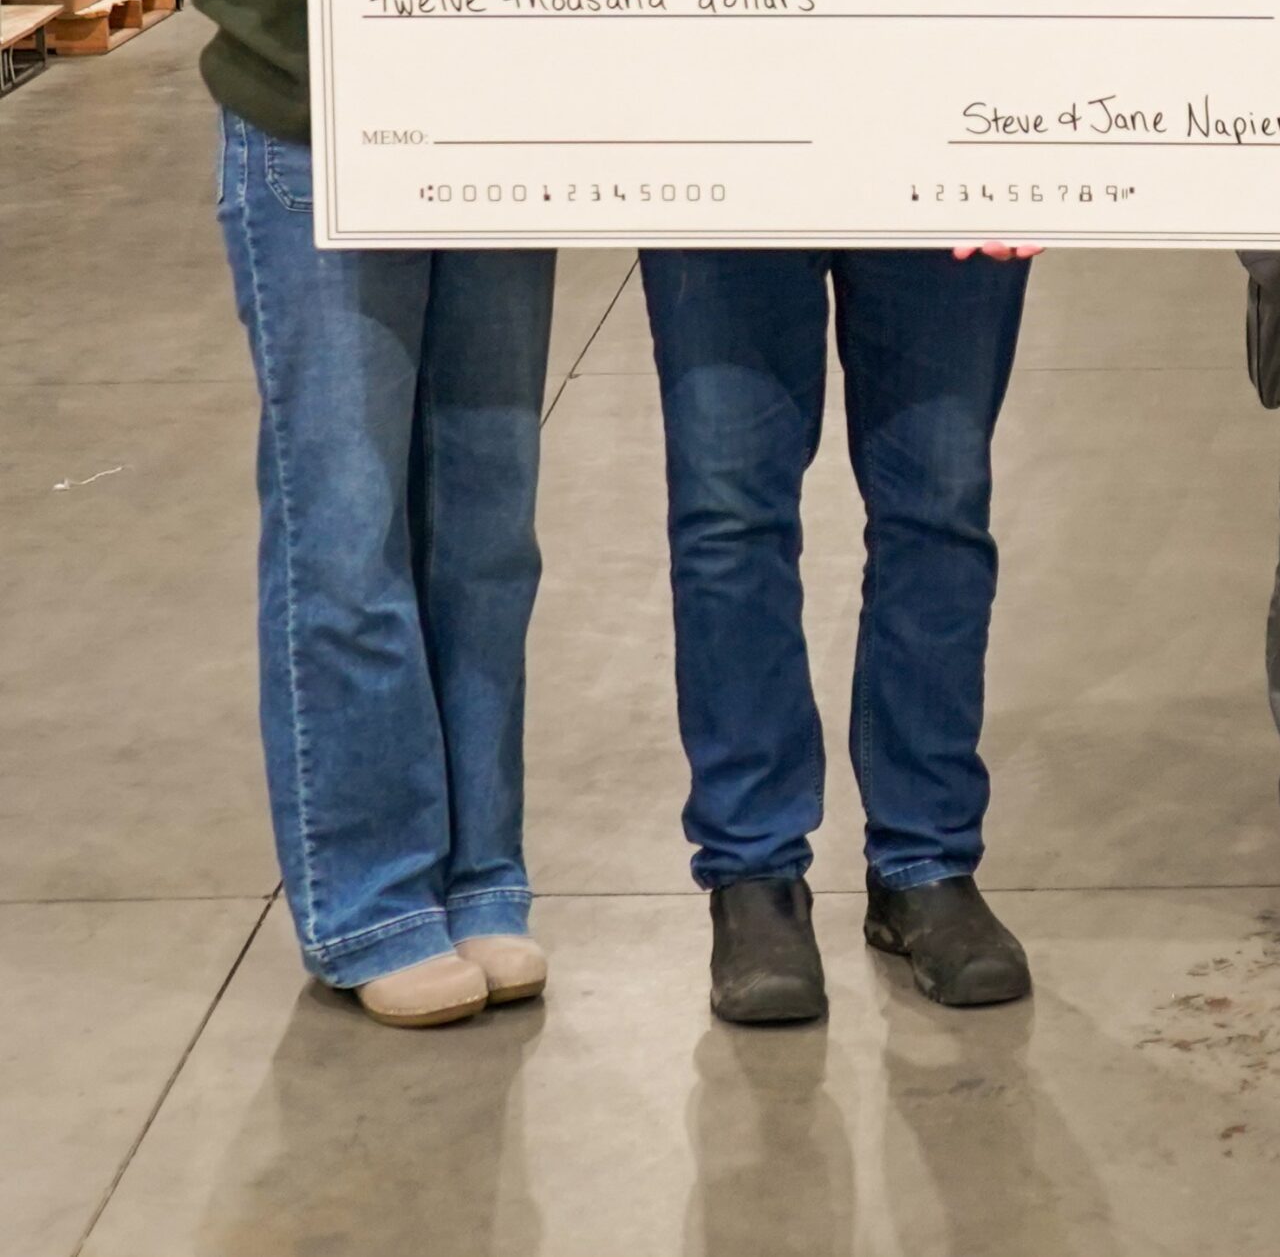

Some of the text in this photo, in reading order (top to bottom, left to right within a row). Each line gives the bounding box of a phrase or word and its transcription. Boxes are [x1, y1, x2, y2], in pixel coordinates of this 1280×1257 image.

[962, 102, 1048, 135] Steve
[1088, 94, 1167, 134] Jane
[362, 129, 429, 146] MEMO:
